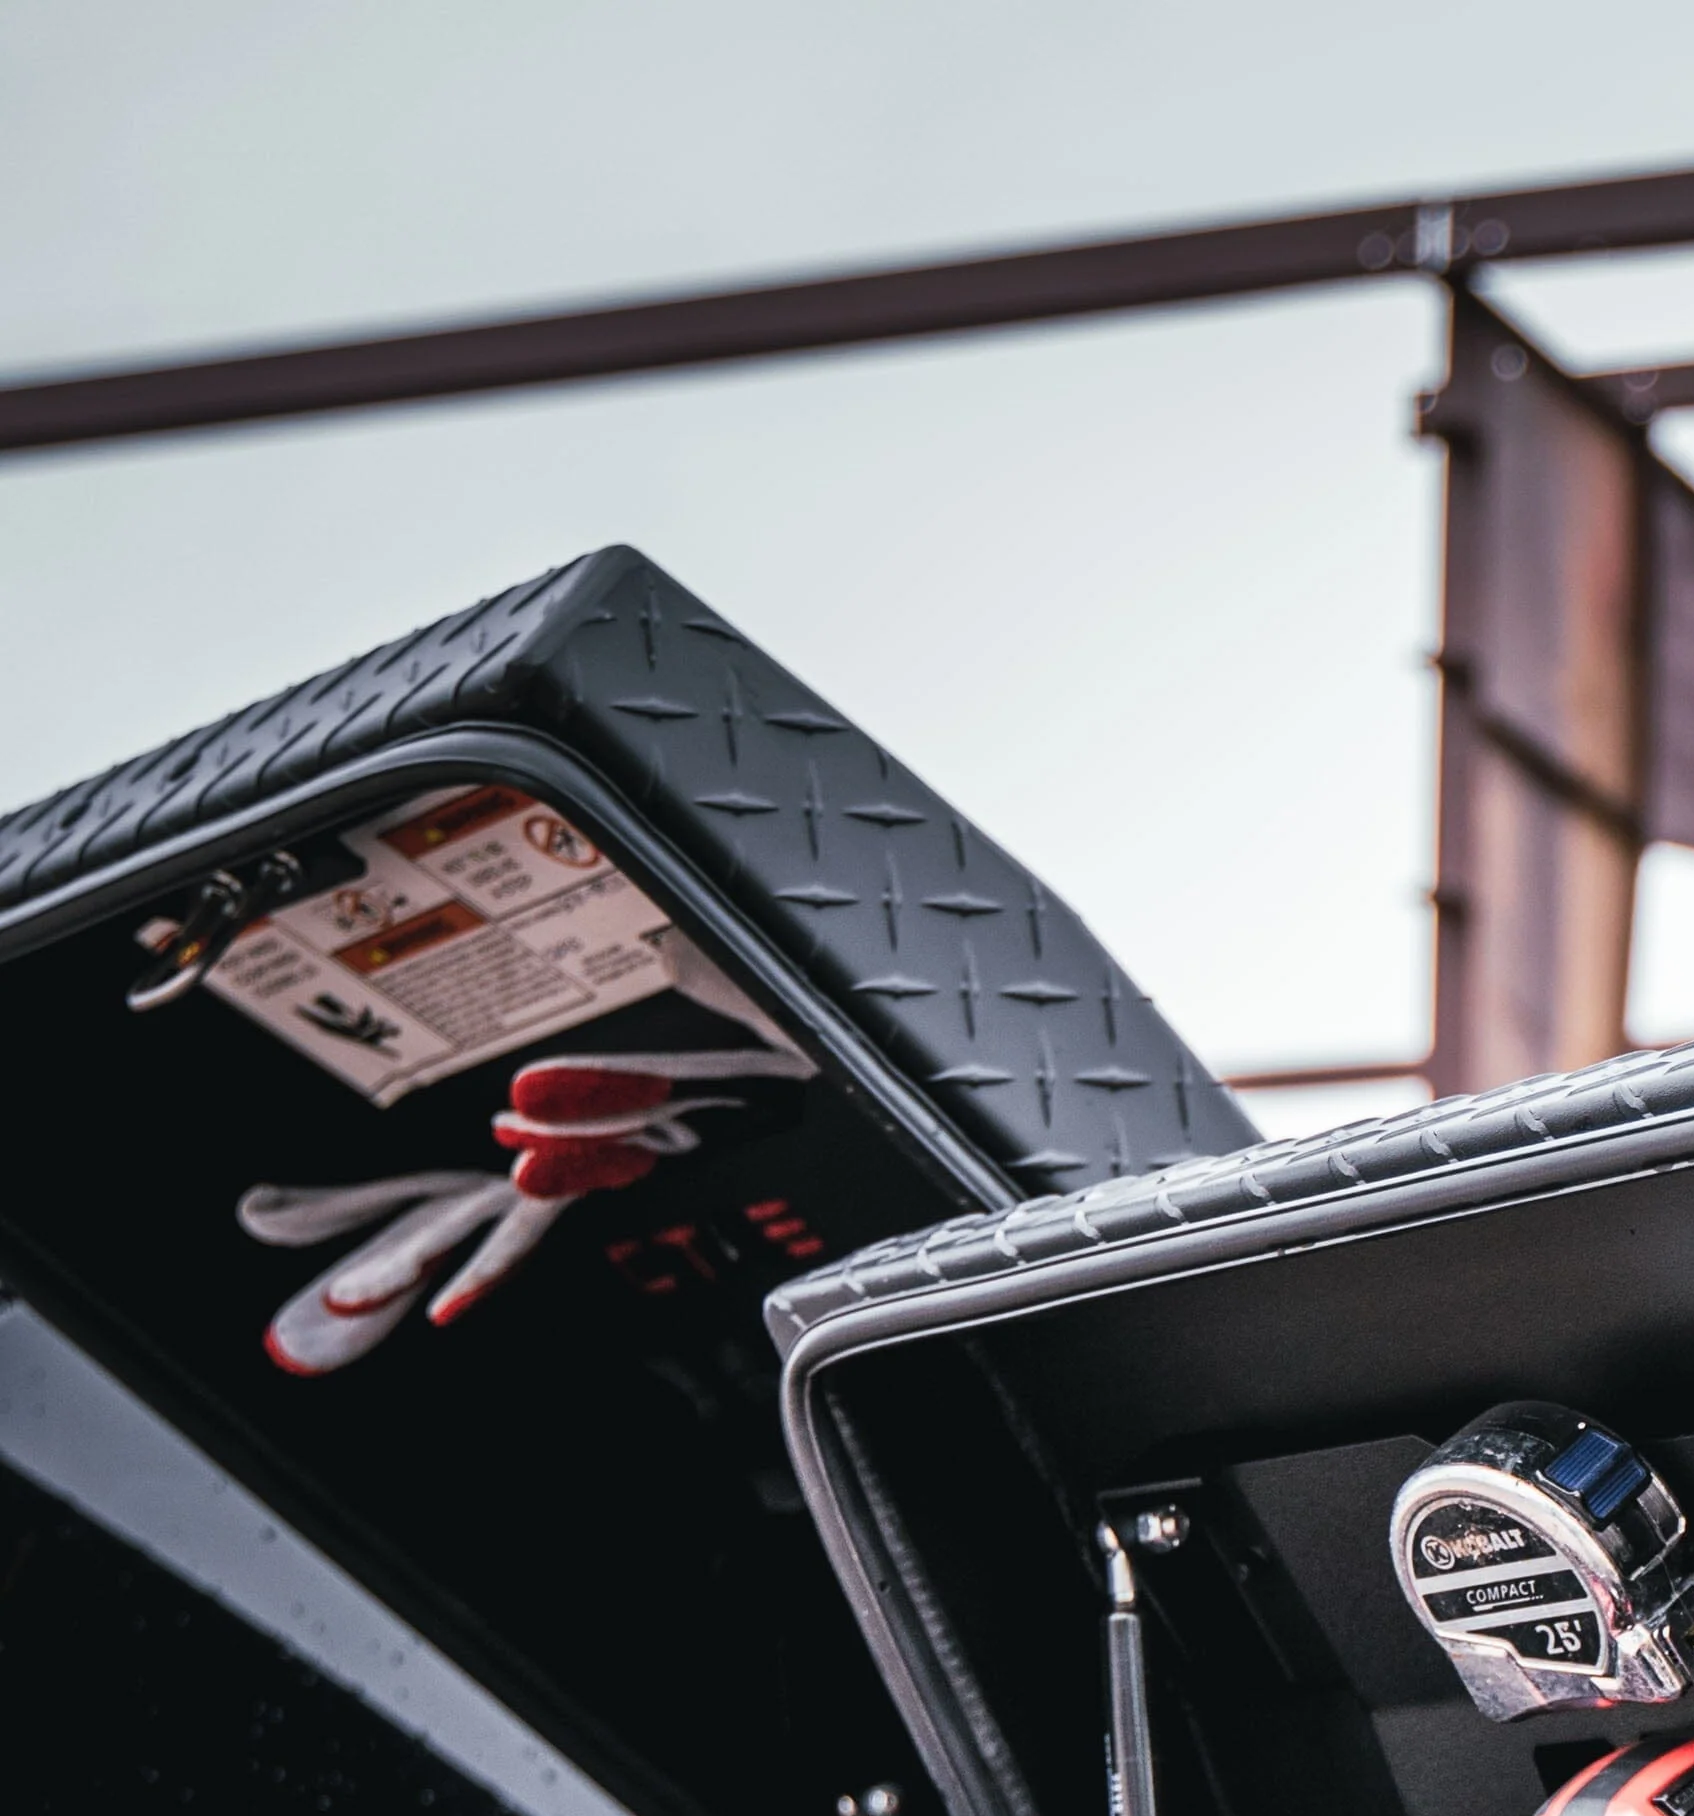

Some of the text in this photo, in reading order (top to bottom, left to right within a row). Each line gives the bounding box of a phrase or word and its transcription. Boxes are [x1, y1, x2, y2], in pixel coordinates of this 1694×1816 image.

[1450, 1529, 1525, 1559] KOBALT
[1466, 1580, 1537, 1604] COMPACT
[1535, 1619, 1583, 1655] 25'
